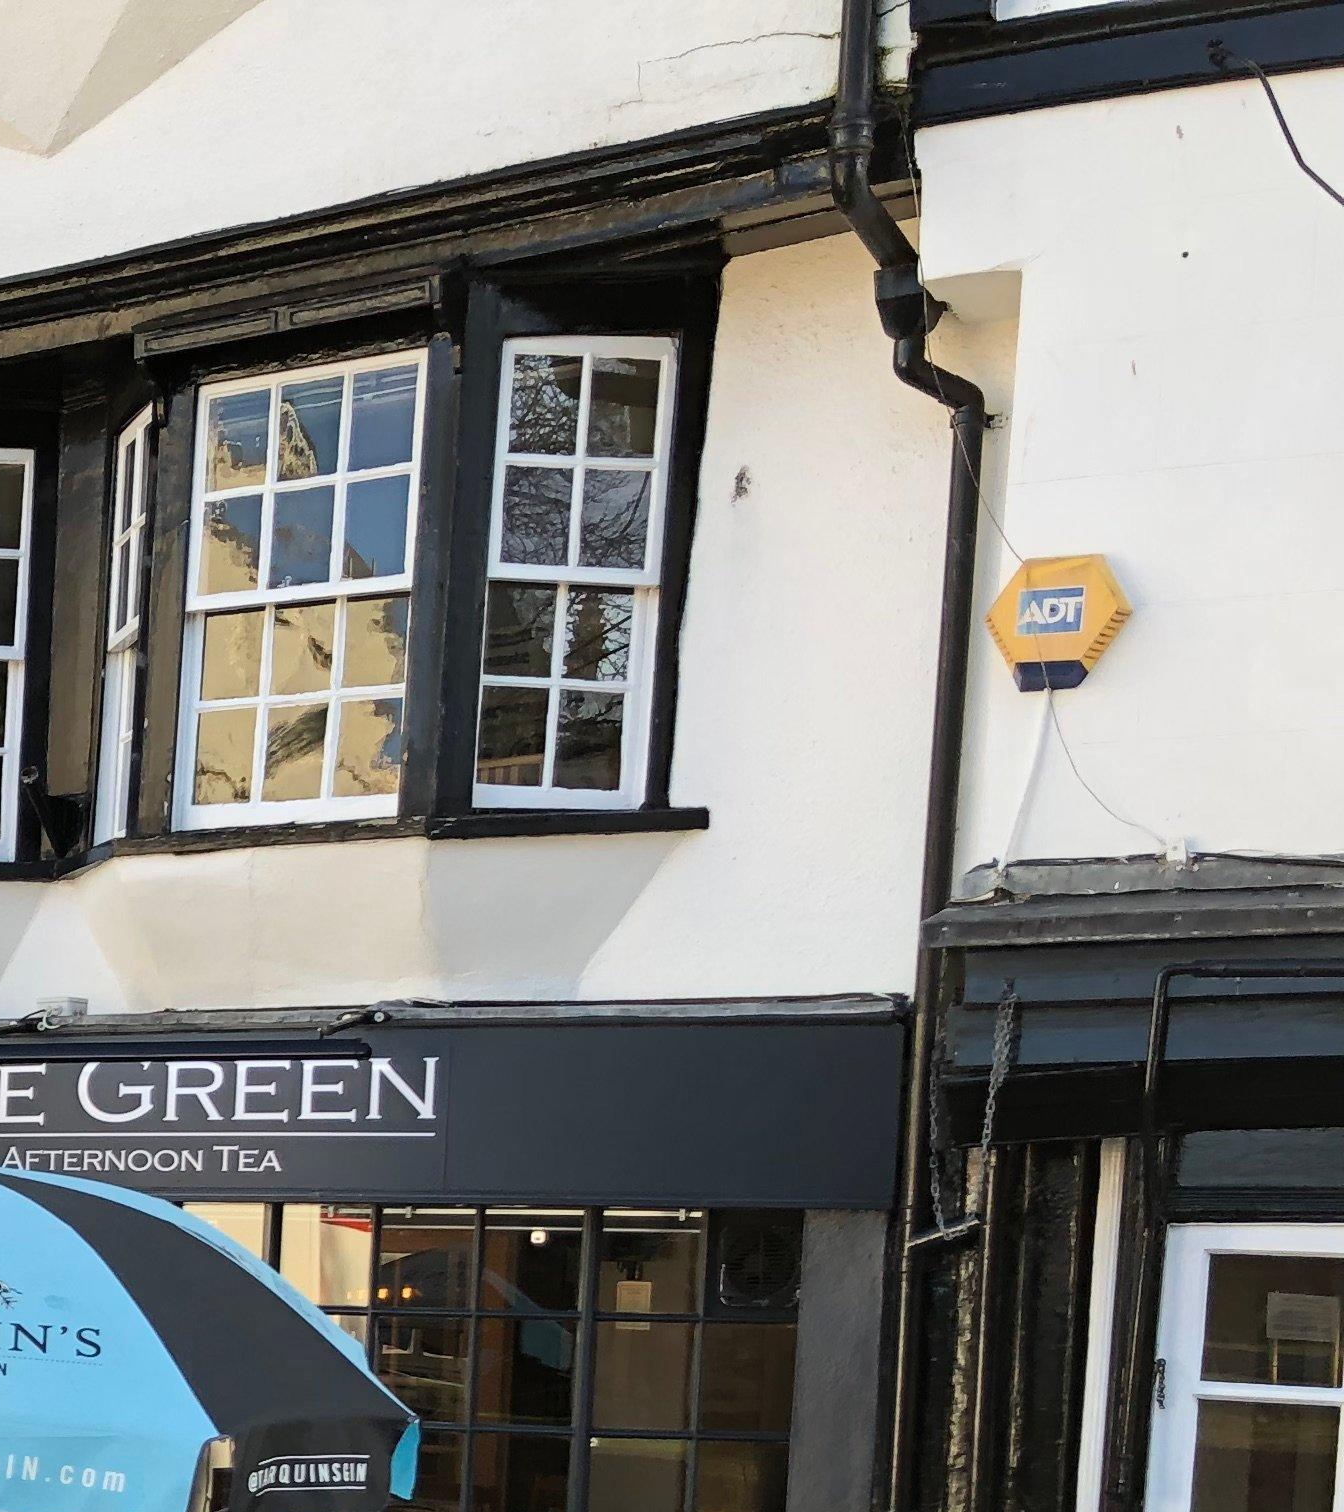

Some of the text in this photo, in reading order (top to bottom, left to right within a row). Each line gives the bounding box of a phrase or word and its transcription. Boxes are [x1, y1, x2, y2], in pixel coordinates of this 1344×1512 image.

[1018, 596, 1083, 625] ADT
[77, 1056, 440, 1123] GREEN
[1, 1146, 204, 1172] AFTERNOON
[212, 1144, 282, 1173] TEA
